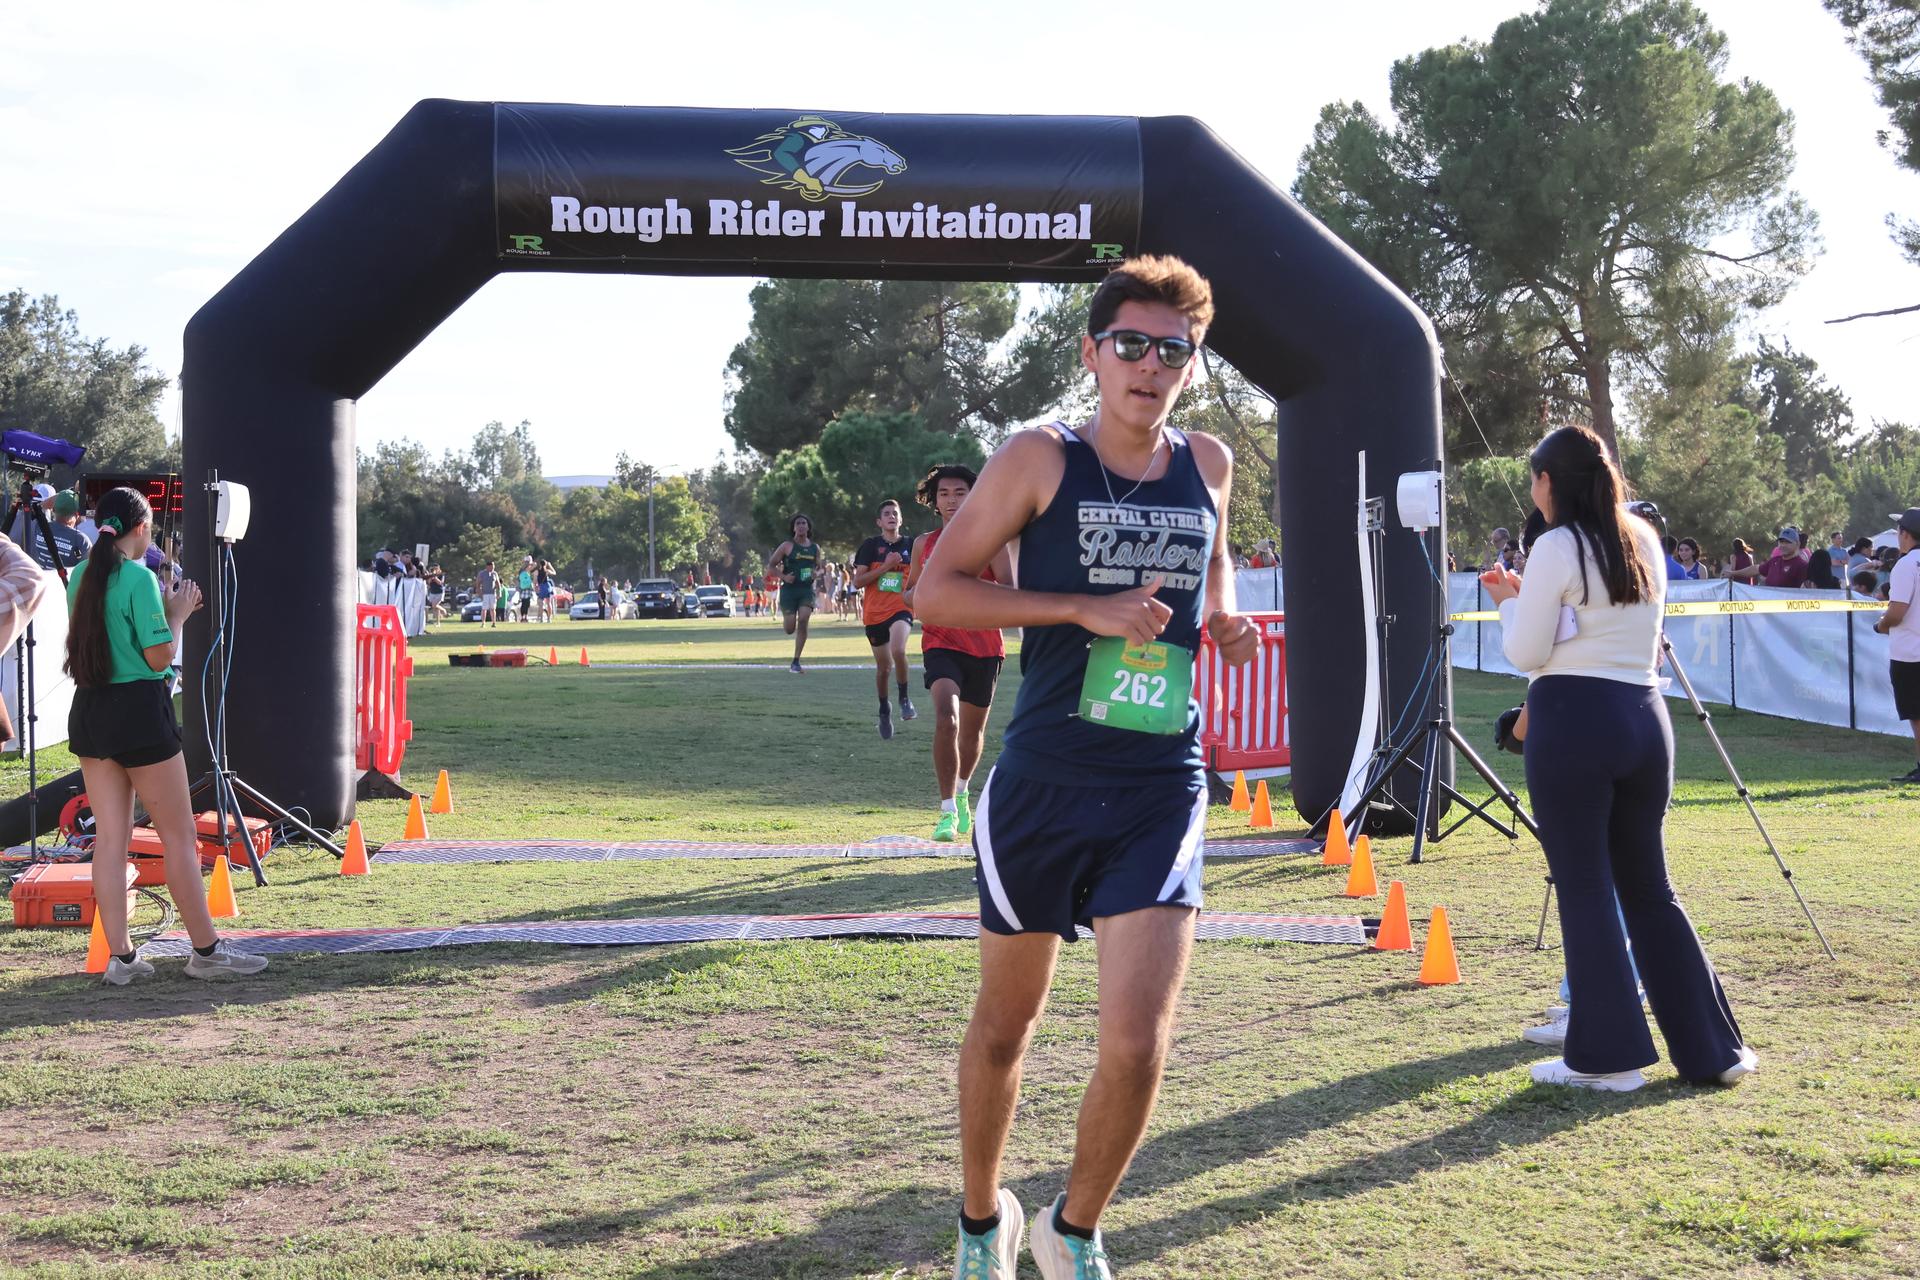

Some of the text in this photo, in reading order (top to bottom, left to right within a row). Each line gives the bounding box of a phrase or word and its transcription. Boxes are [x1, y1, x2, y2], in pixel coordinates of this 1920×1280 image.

[550, 196, 1092, 243] Rough Rider Invitational
[20, 448, 43, 458] LYNX
[1078, 507, 1146, 526] CENTRAL
[1078, 525, 1207, 571] Raiders
[1088, 568, 1135, 585] CROSS
[1110, 669, 1167, 708] 262
